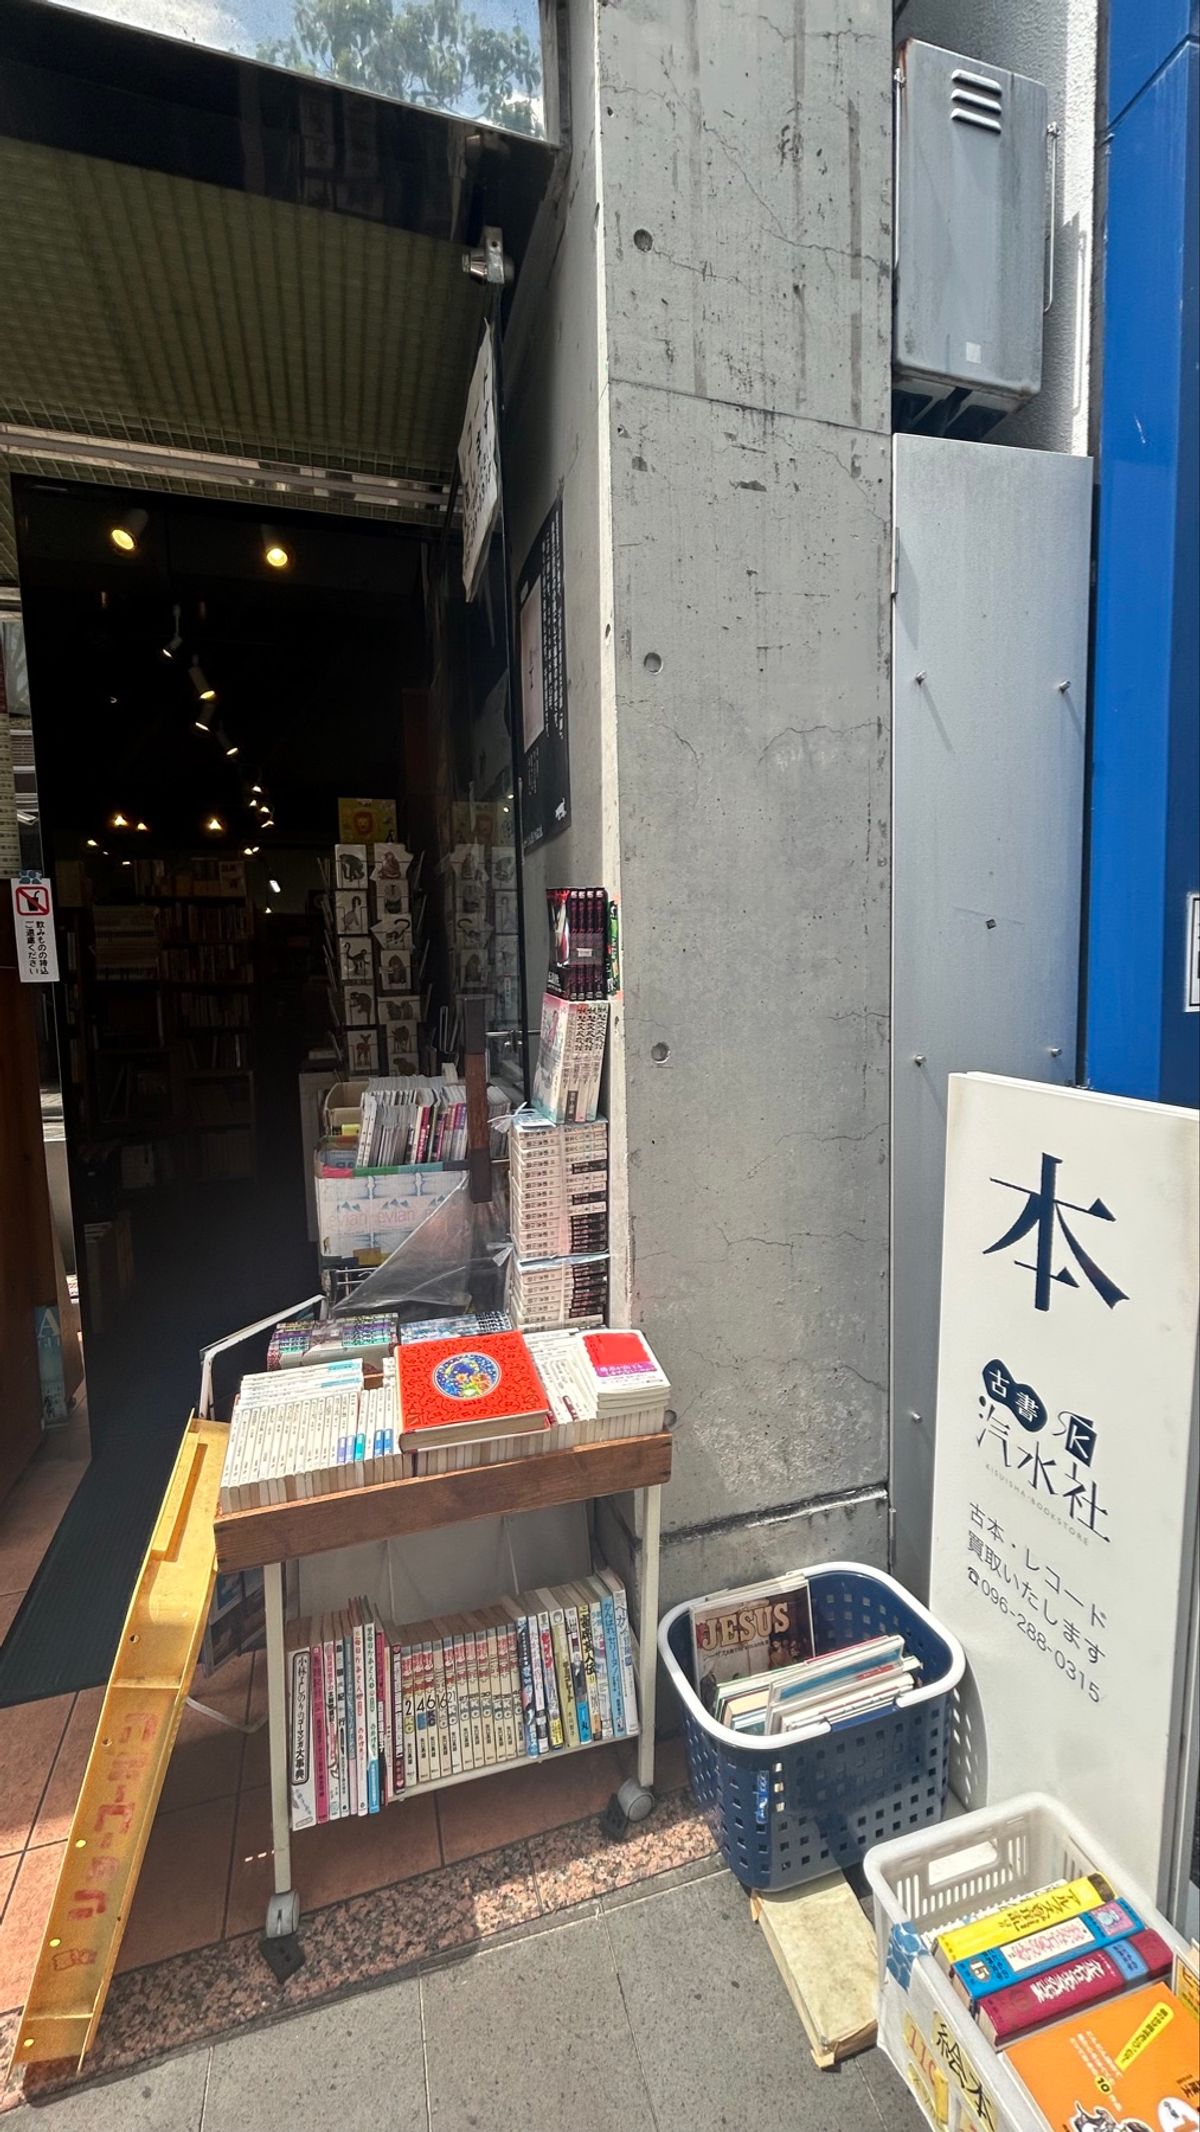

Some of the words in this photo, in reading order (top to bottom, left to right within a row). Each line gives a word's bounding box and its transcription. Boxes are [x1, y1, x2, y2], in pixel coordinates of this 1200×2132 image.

[983, 1152, 1130, 1311] 本
[989, 1369, 1040, 1422] 古書
[976, 1395, 1112, 1544] 汽水社
[969, 1502, 1107, 1629] 古本・レコード
[968, 1530, 1106, 1664] 買取いたします
[702, 1602, 790, 1651] JESUS
[405, 1700, 412, 1716] 2
[417, 1694, 425, 1712] 4
[426, 1694, 436, 1709] 6
[970, 1961, 989, 1981] 15
[1097, 2078, 1110, 2092] 10
